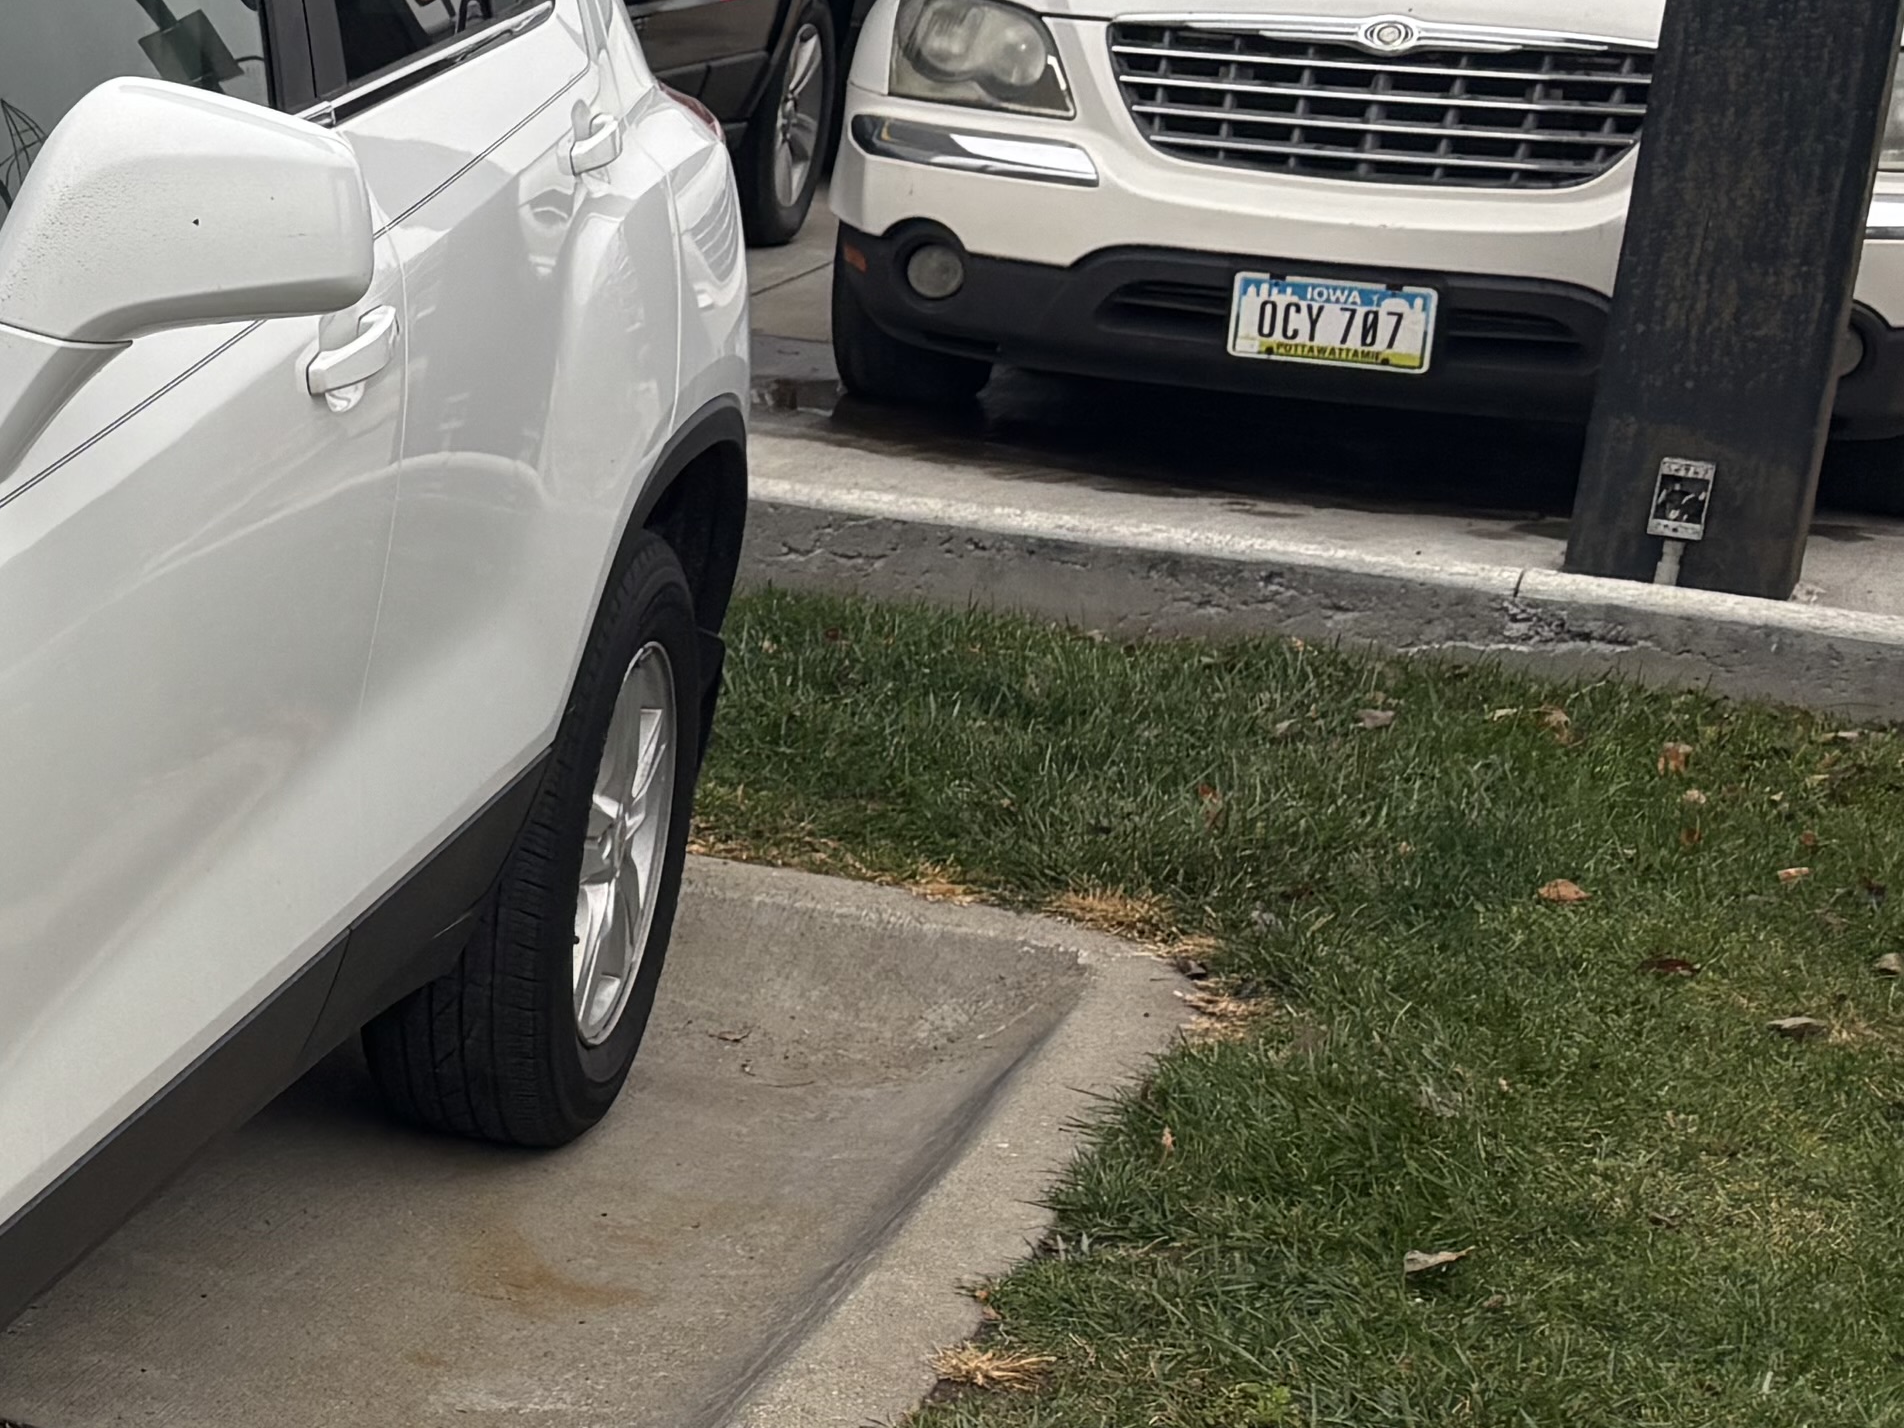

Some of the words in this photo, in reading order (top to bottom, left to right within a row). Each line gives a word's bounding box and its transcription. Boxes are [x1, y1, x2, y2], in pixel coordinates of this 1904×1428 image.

[1306, 286, 1362, 305] IOWA
[1257, 300, 1325, 342] OCY
[1339, 307, 1405, 349] 707
